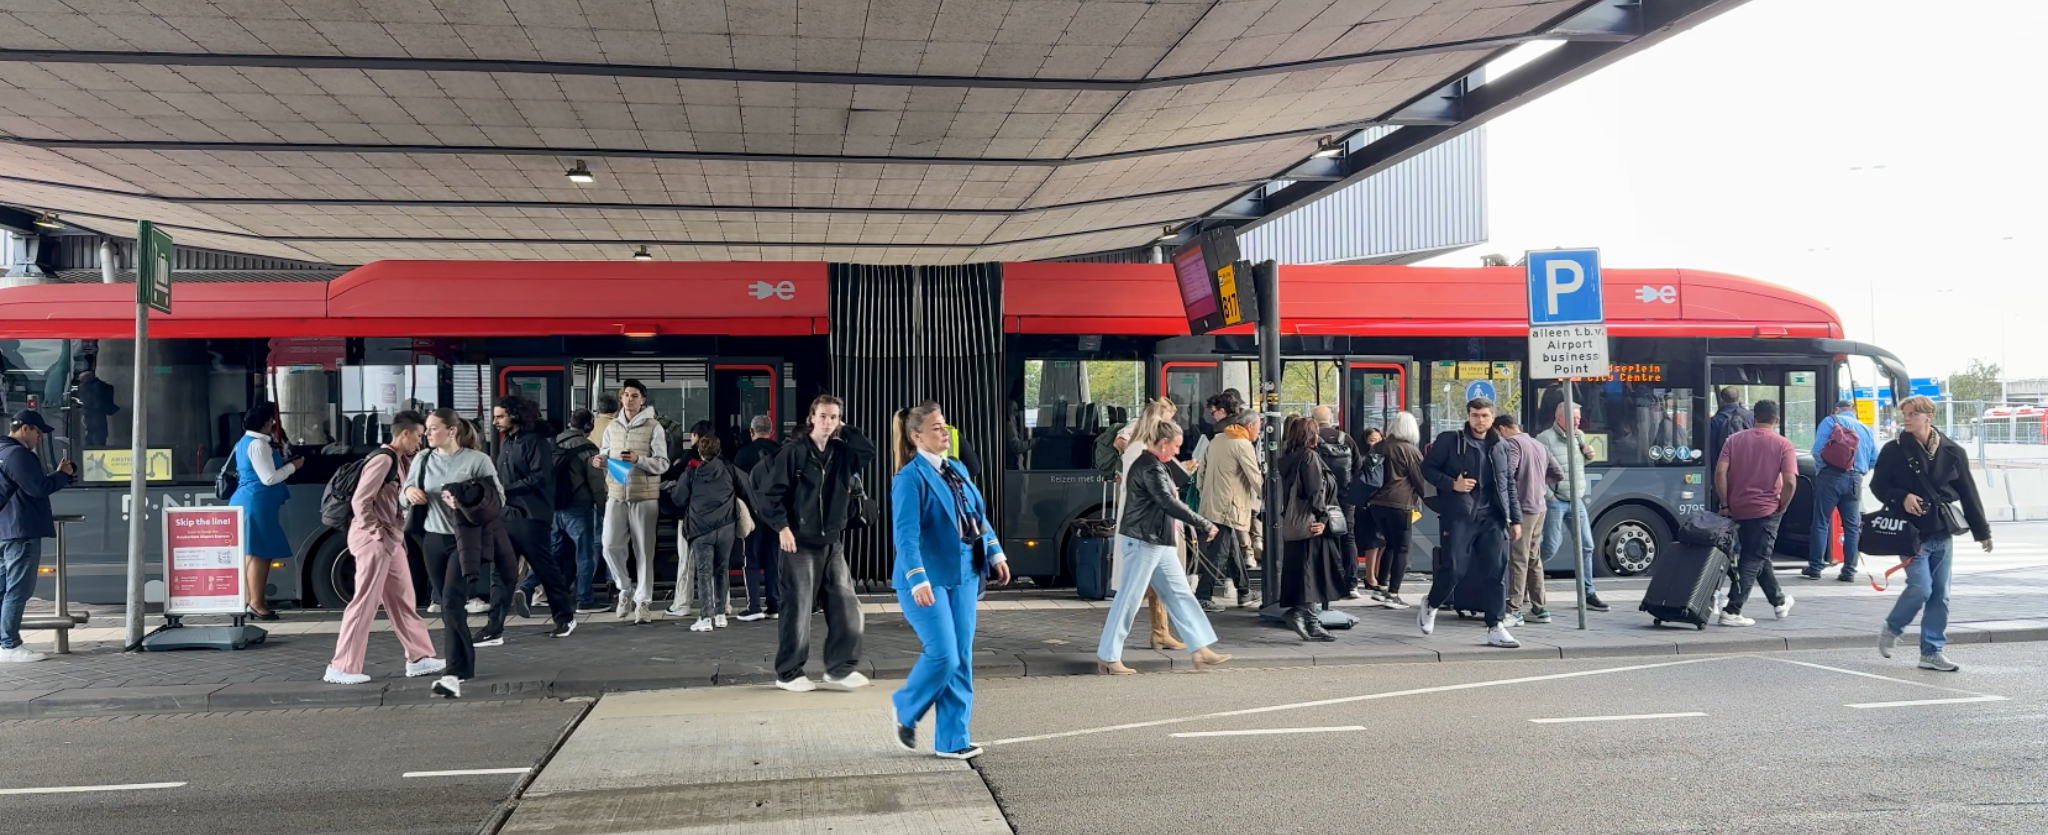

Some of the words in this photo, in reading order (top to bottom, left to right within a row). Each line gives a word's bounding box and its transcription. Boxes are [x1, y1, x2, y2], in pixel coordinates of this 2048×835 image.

[1545, 259, 1585, 315] P
[1532, 328, 1571, 338] alleen
[1574, 327, 1605, 337] t.b.v.
[1547, 339, 1593, 351] Airport
[1543, 352, 1600, 362] business
[1554, 364, 1589, 374] Point
[1608, 364, 1660, 373] dseplein
[1620, 373, 1662, 382] Centre
[1050, 475, 1077, 483] Reizen
[1077, 475, 1094, 483] met
[1679, 503, 1705, 515] 9795
[175, 518, 195, 527] Skip
[196, 517, 211, 526] the
[212, 516, 231, 525] line!
